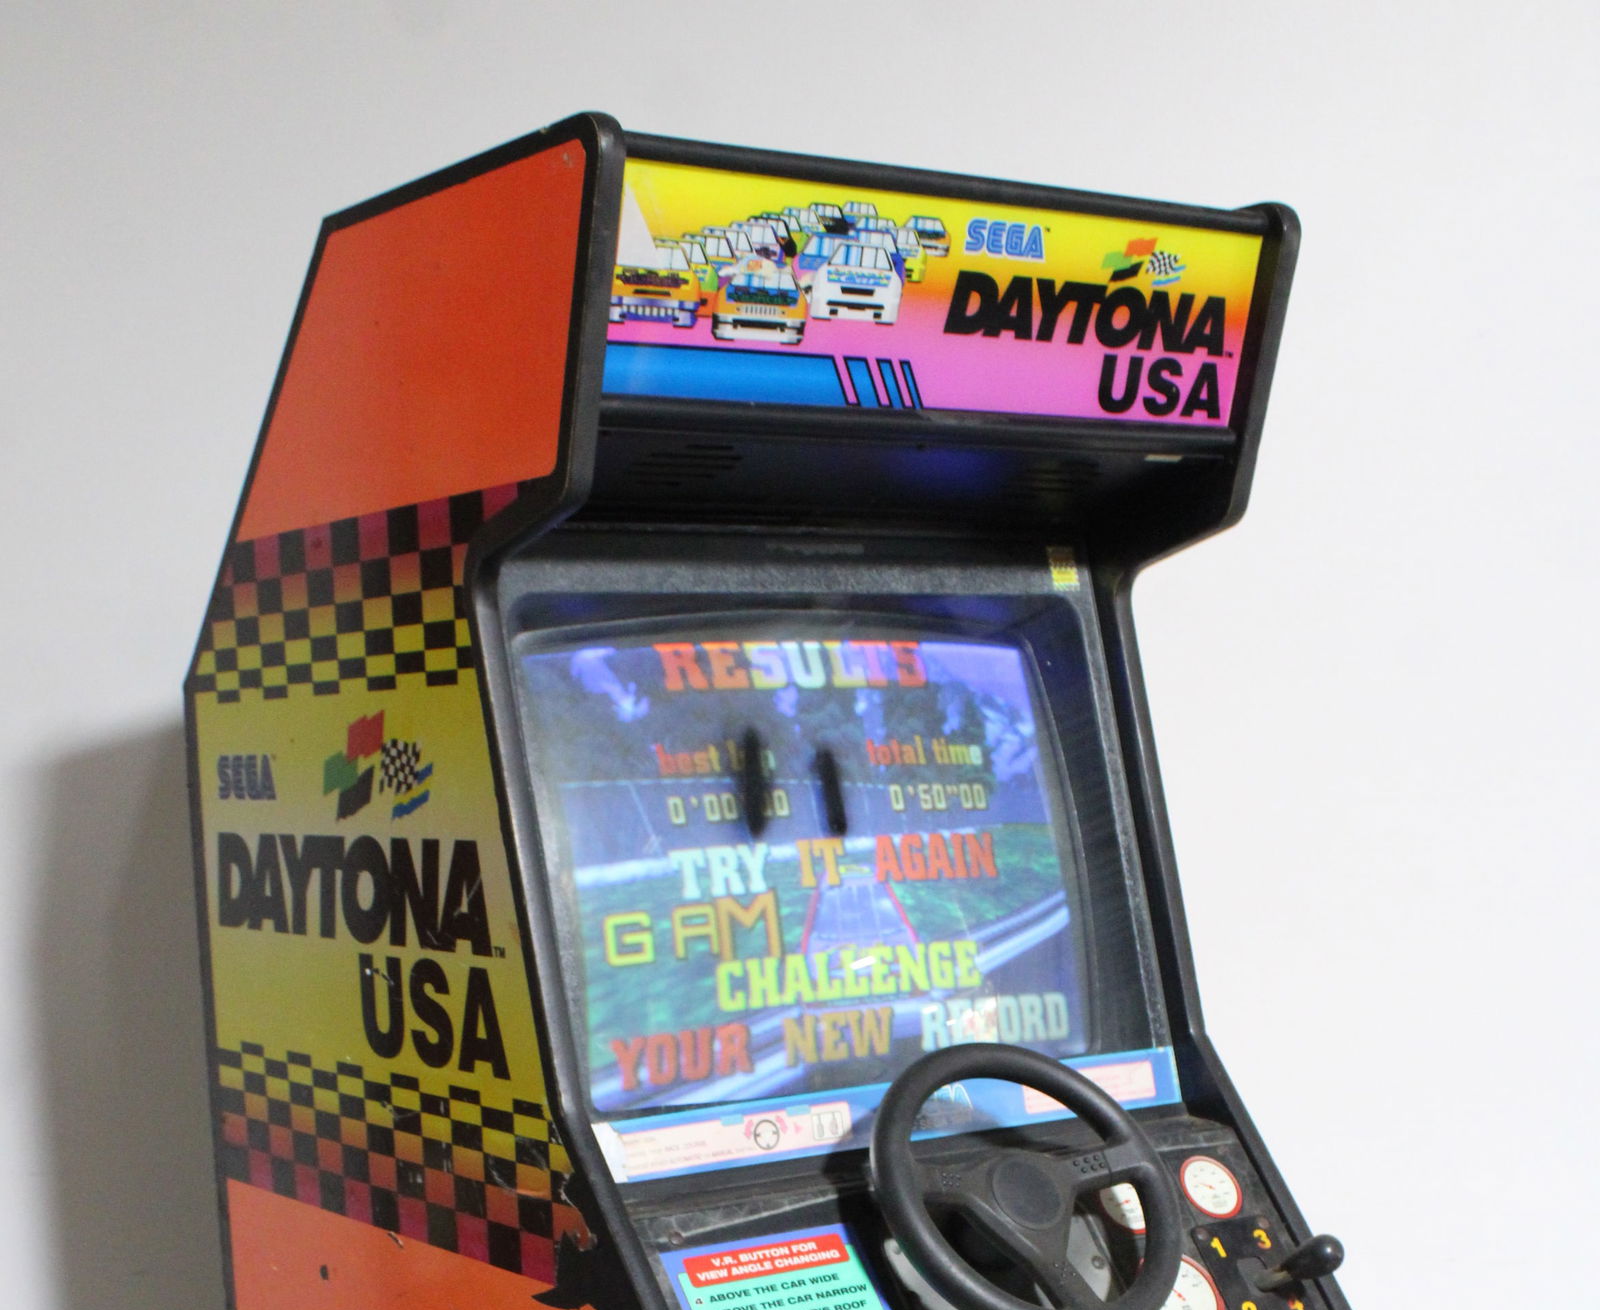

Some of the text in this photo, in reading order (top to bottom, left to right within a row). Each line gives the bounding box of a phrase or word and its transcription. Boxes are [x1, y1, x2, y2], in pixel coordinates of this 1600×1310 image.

[965, 217, 1045, 261] SEGA
[943, 270, 1226, 357] DAYTONA
[1098, 353, 1220, 419] USA
[653, 641, 927, 691] RESULTS
[217, 754, 276, 800] SEGA
[655, 743, 721, 776] best
[866, 735, 926, 765] total
[932, 738, 983, 765] time
[668, 832, 997, 898] TRY IT AGAIN
[217, 832, 493, 958] DAYTONA
[716, 940, 982, 1011] CHALLENGE
[359, 953, 510, 1080] USA
[611, 1023, 755, 1090] YOUR
[782, 1006, 893, 1067] NEW
[696, 1249, 841, 1281] VIEW ANGLE CHANGING
[710, 1241, 817, 1267] V.R. BUTTON FOR
[1211, 1229, 1271, 1258] 1 3
[709, 1288, 751, 1303] ABOVE
[754, 1284, 778, 1295] THE
[781, 1279, 807, 1291] CAR
[809, 1273, 840, 1285] WIDE
[760, 1298, 785, 1310] THE
[788, 1293, 814, 1305] CAR
[816, 1284, 867, 1299] NARROW
